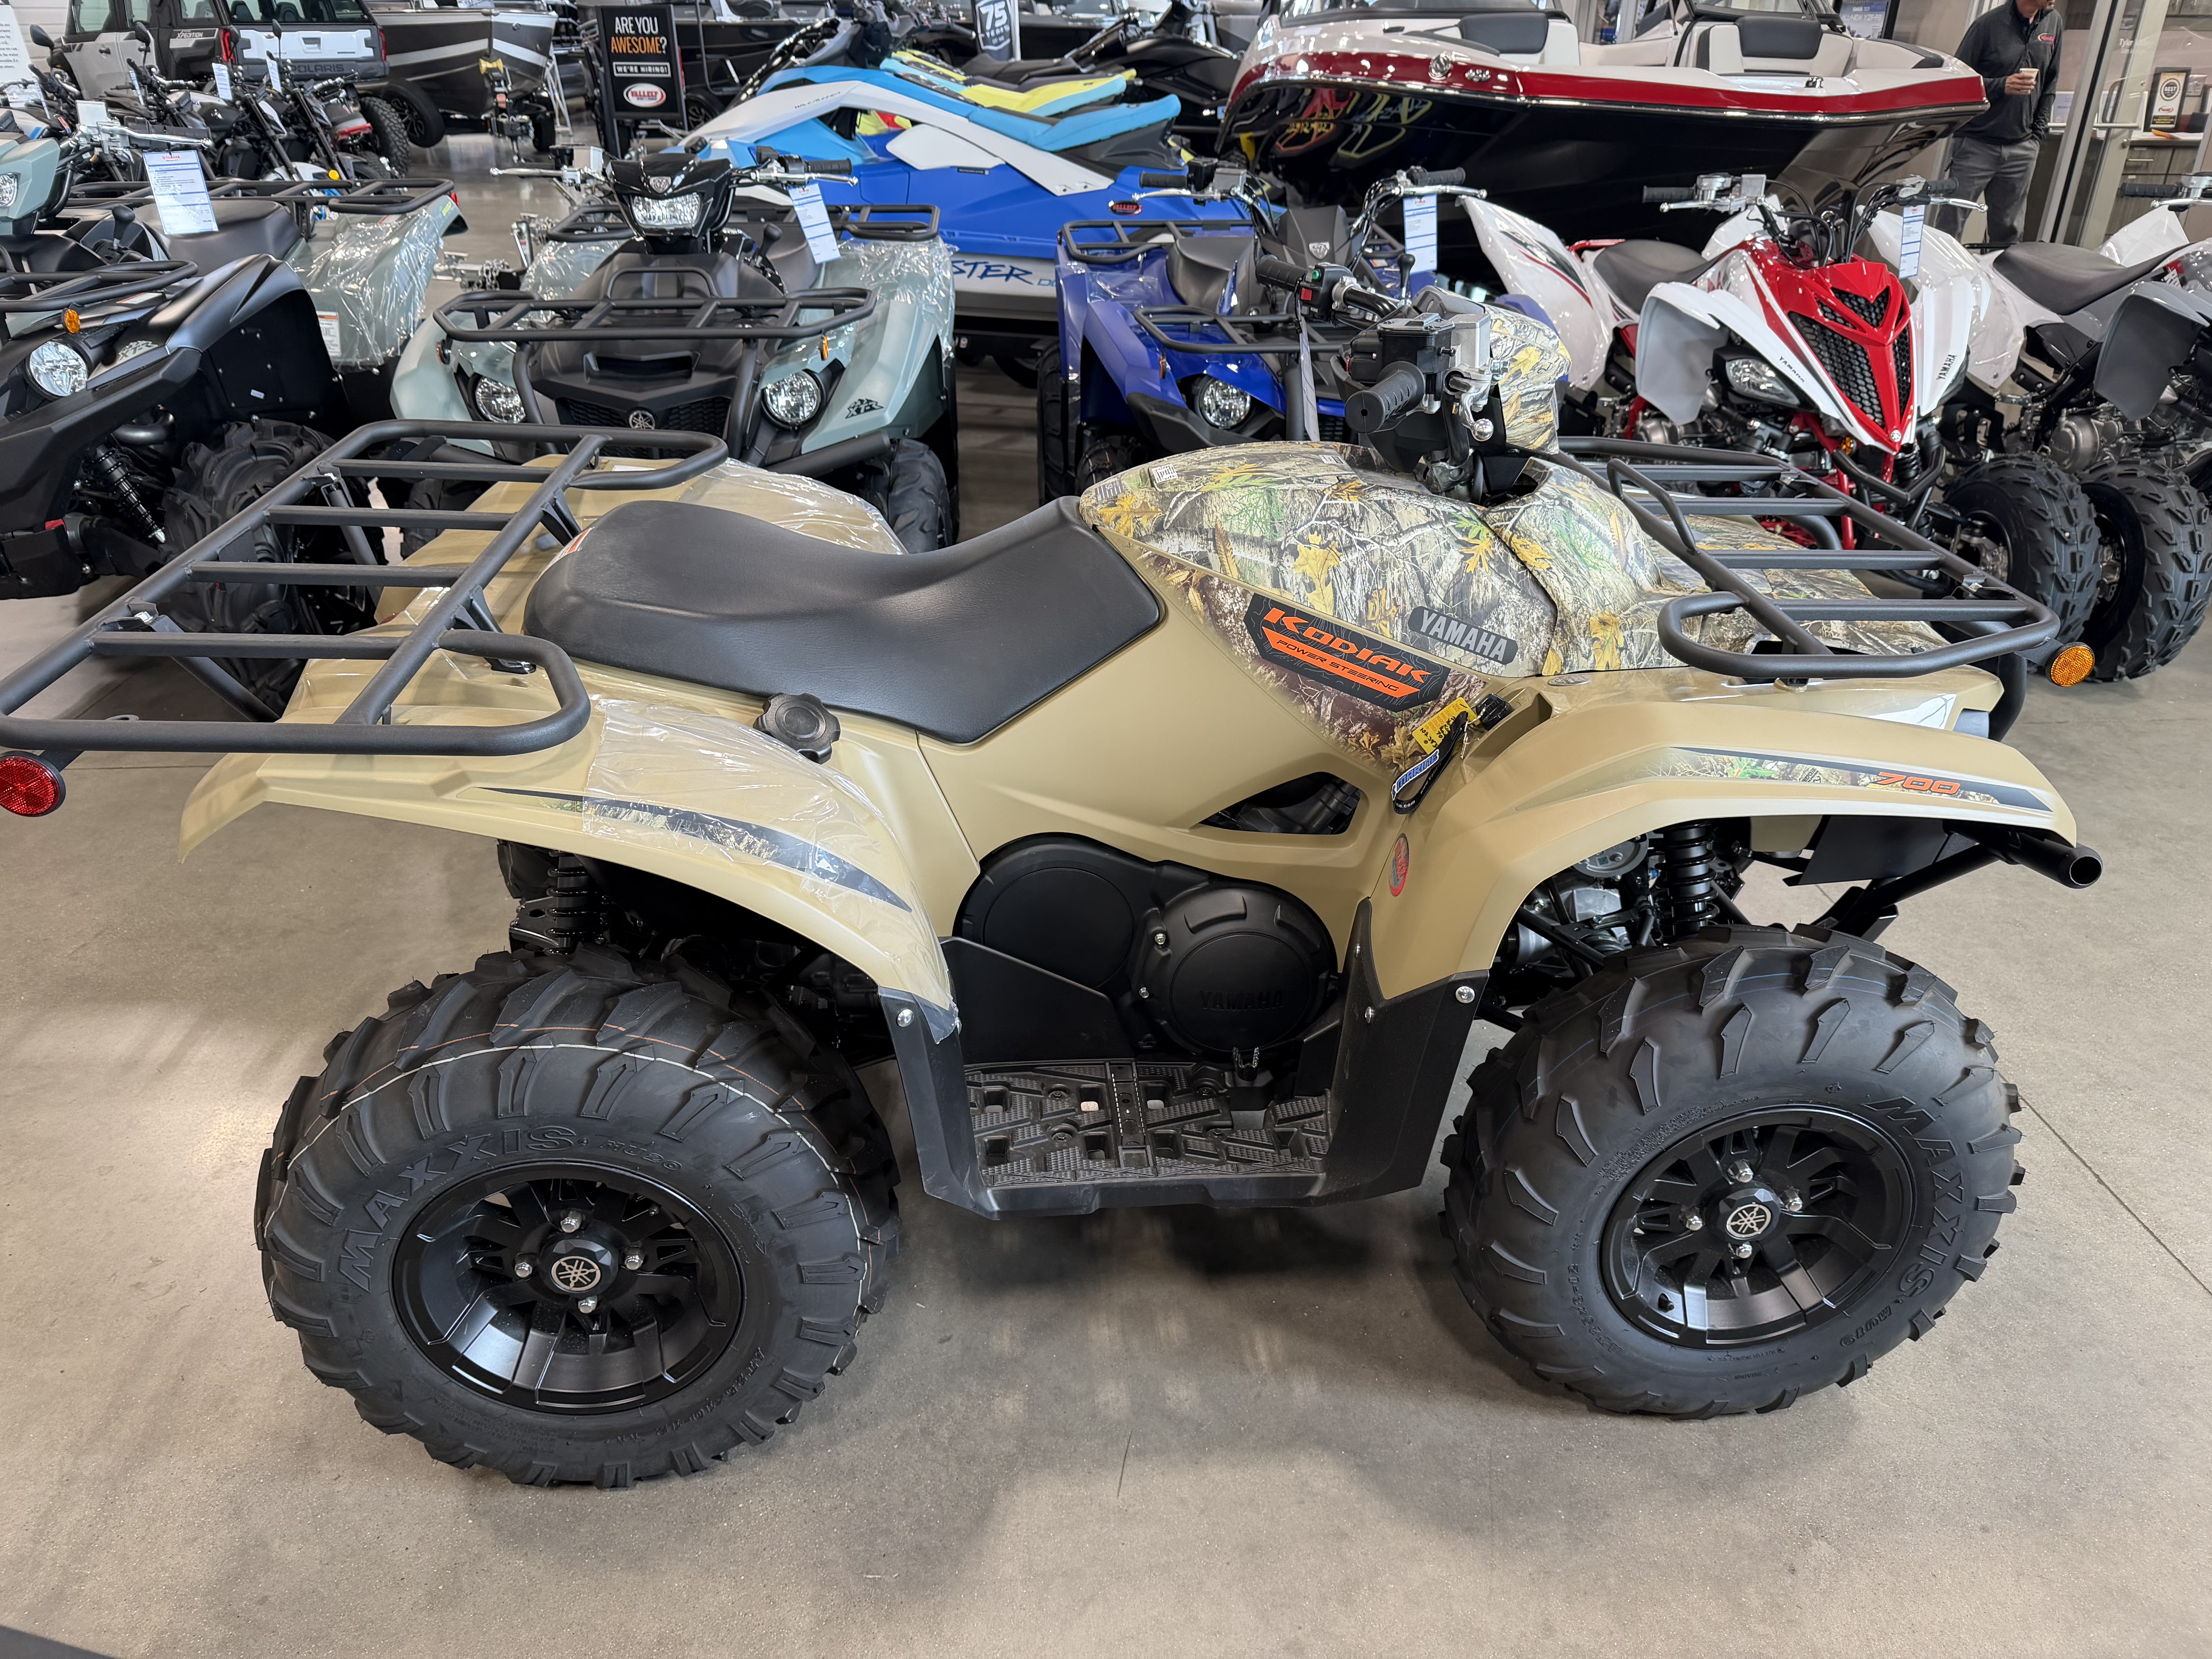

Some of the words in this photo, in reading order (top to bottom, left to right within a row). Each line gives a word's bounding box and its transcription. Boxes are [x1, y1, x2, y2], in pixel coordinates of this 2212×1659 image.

[615, 17, 635, 34] ARE
[634, 17, 658, 34] YOU
[979, 1, 1007, 31] 75
[611, 36, 667, 54] AWESOME?
[951, 260, 1034, 285] STER
[1936, 354, 1957, 380] YAMAHA
[1264, 607, 1432, 683] KODIAK
[1420, 609, 1507, 662] YAMAHA
[1276, 639, 1326, 663] POWER
[1329, 662, 1400, 691] STEERING
[1396, 750, 1438, 792] MARINE
[1879, 772, 1960, 794] 700
[1200, 990, 1284, 1011] YAMAHA
[599, 1140, 682, 1170] MU20
[339, 1125, 577, 1292] MAXXIS
[1860, 1096, 1964, 1297] MAXXIS
[1839, 1304, 1892, 1349] MU19
